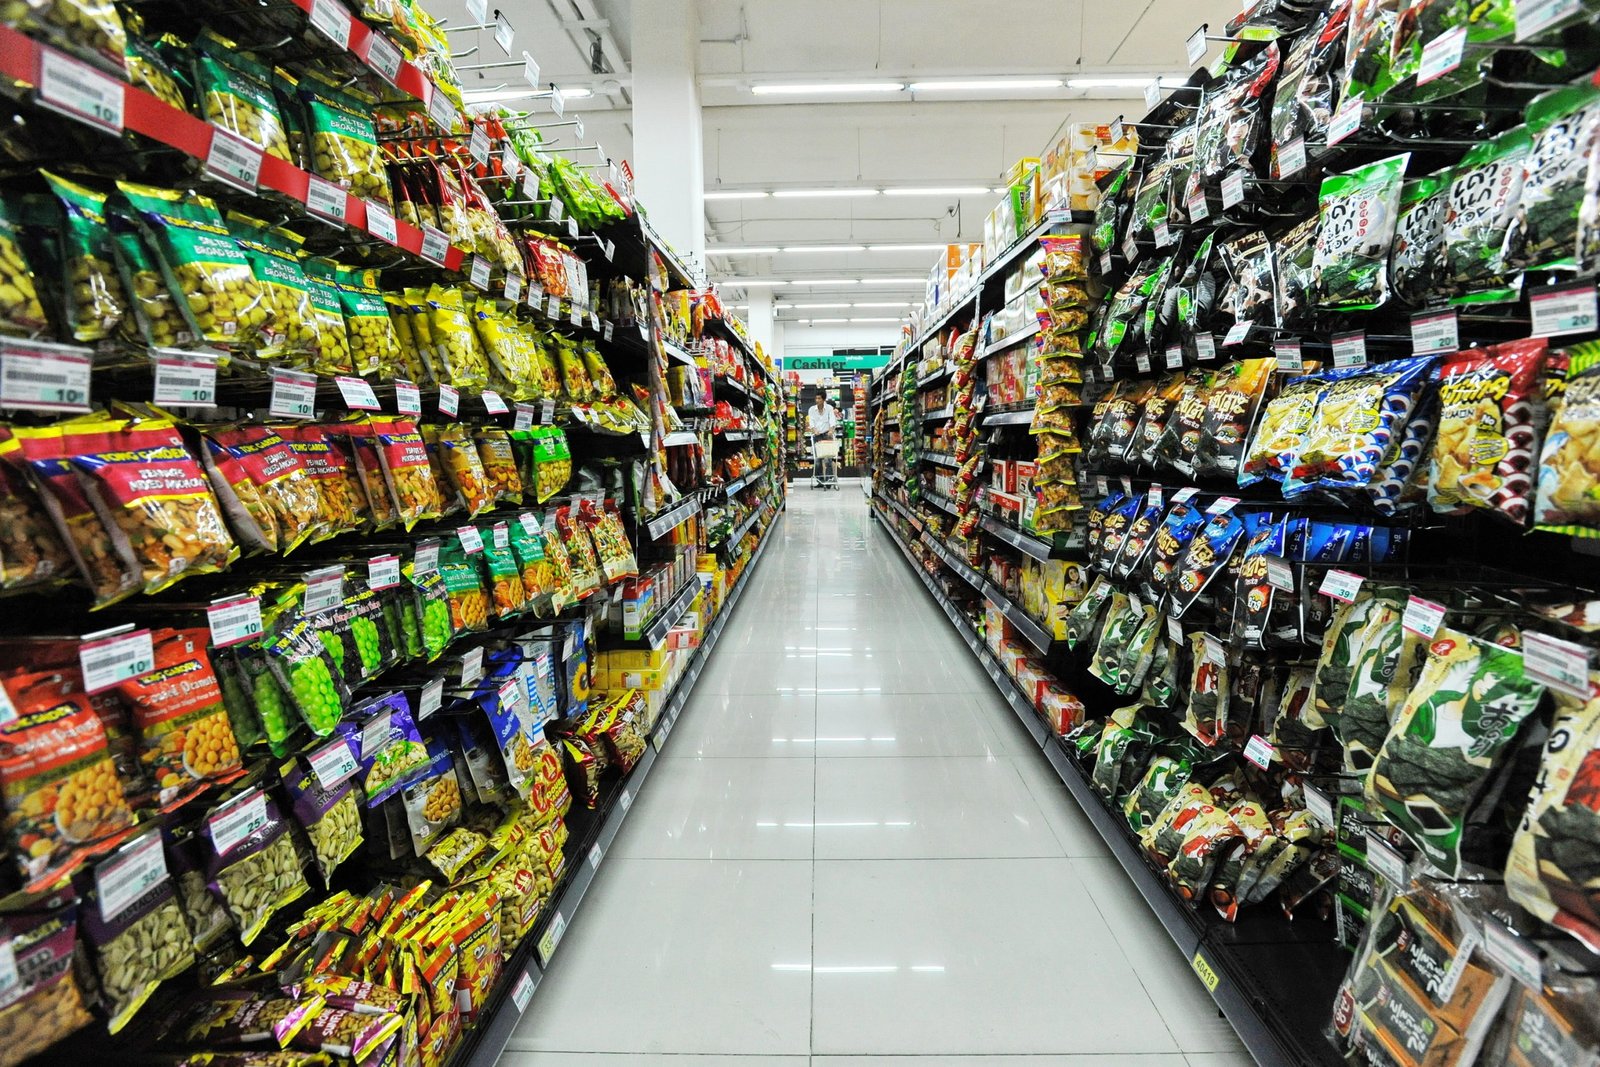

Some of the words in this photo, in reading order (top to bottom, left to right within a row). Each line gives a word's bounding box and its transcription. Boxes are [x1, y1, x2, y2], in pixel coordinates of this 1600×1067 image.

[330, 121, 357, 136] BROAD
[338, 115, 366, 129] SALTED
[198, 236, 232, 249] SALTED
[194, 244, 225, 258] BROAD
[270, 260, 296, 274] SALTED
[264, 267, 290, 281] BROAD
[308, 287, 333, 299] SALTED
[1439, 338, 1452, 347] 20
[792, 358, 846, 370] Cashier
[56, 389, 79, 403] 10
[192, 390, 207, 402] 10
[297, 404, 308, 414] 10
[1481, 413, 1496, 426] No
[97, 450, 140, 463] TONG
[1339, 588, 1350, 598] 39
[245, 623, 257, 635] 10
[128, 660, 146, 675] 10
[342, 762, 353, 774] 25
[247, 818, 260, 832] 25
[459, 937, 474, 951] TONG
[1195, 958, 1216, 987] 40419
